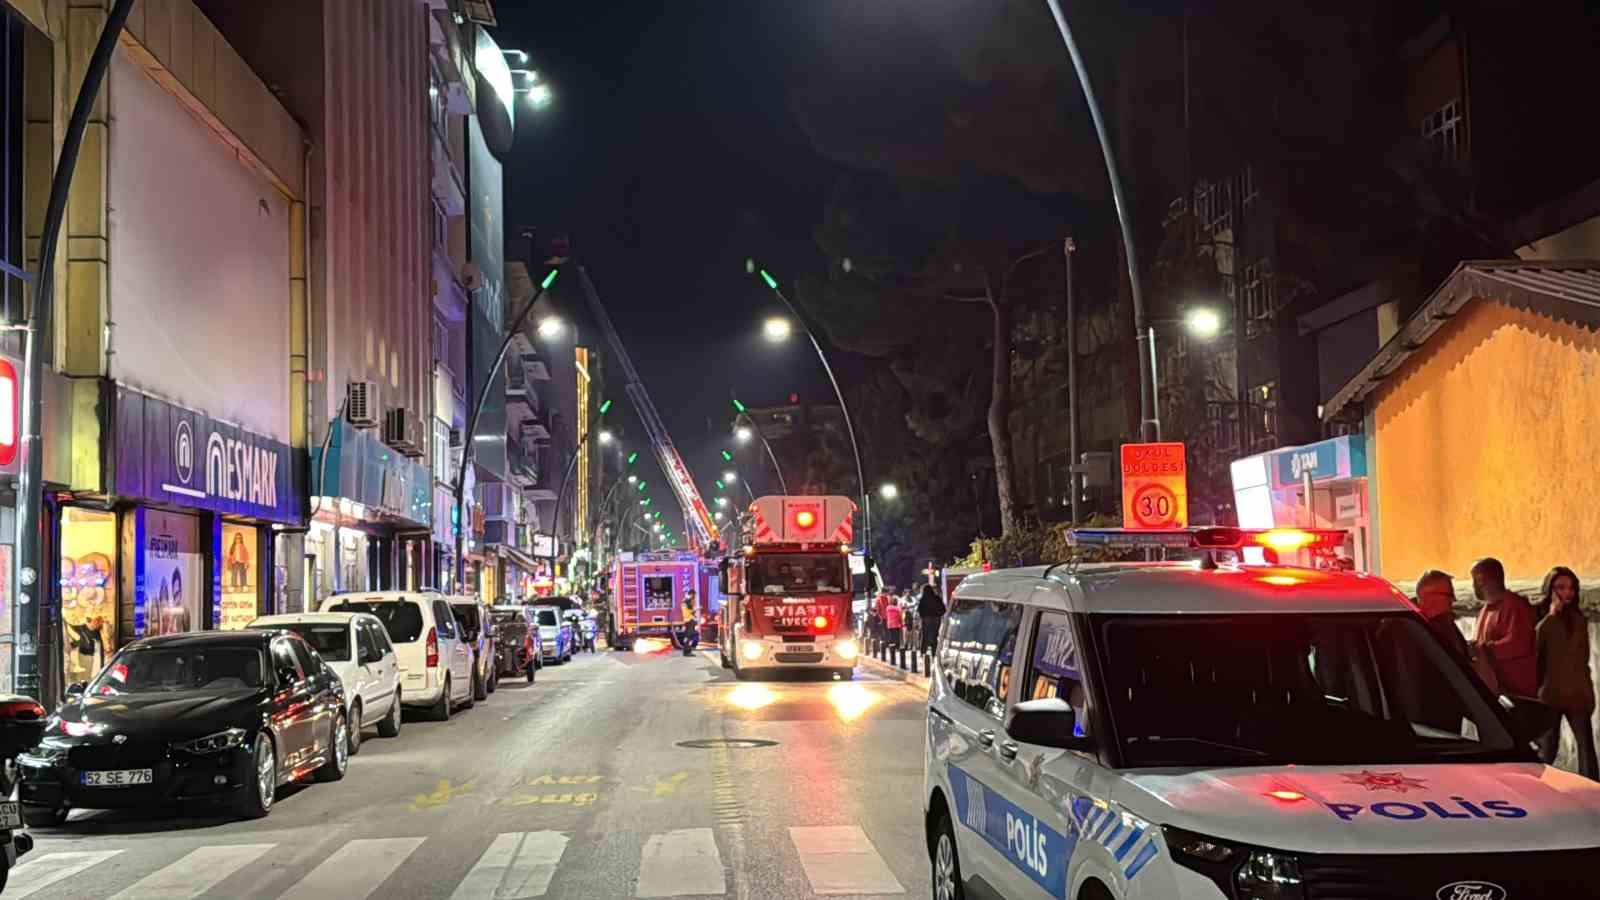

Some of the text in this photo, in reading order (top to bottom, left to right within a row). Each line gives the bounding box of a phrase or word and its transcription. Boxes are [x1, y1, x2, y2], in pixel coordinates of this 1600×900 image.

[1141, 496, 1169, 517] 30
[87, 769, 152, 785] 52 SE 776
